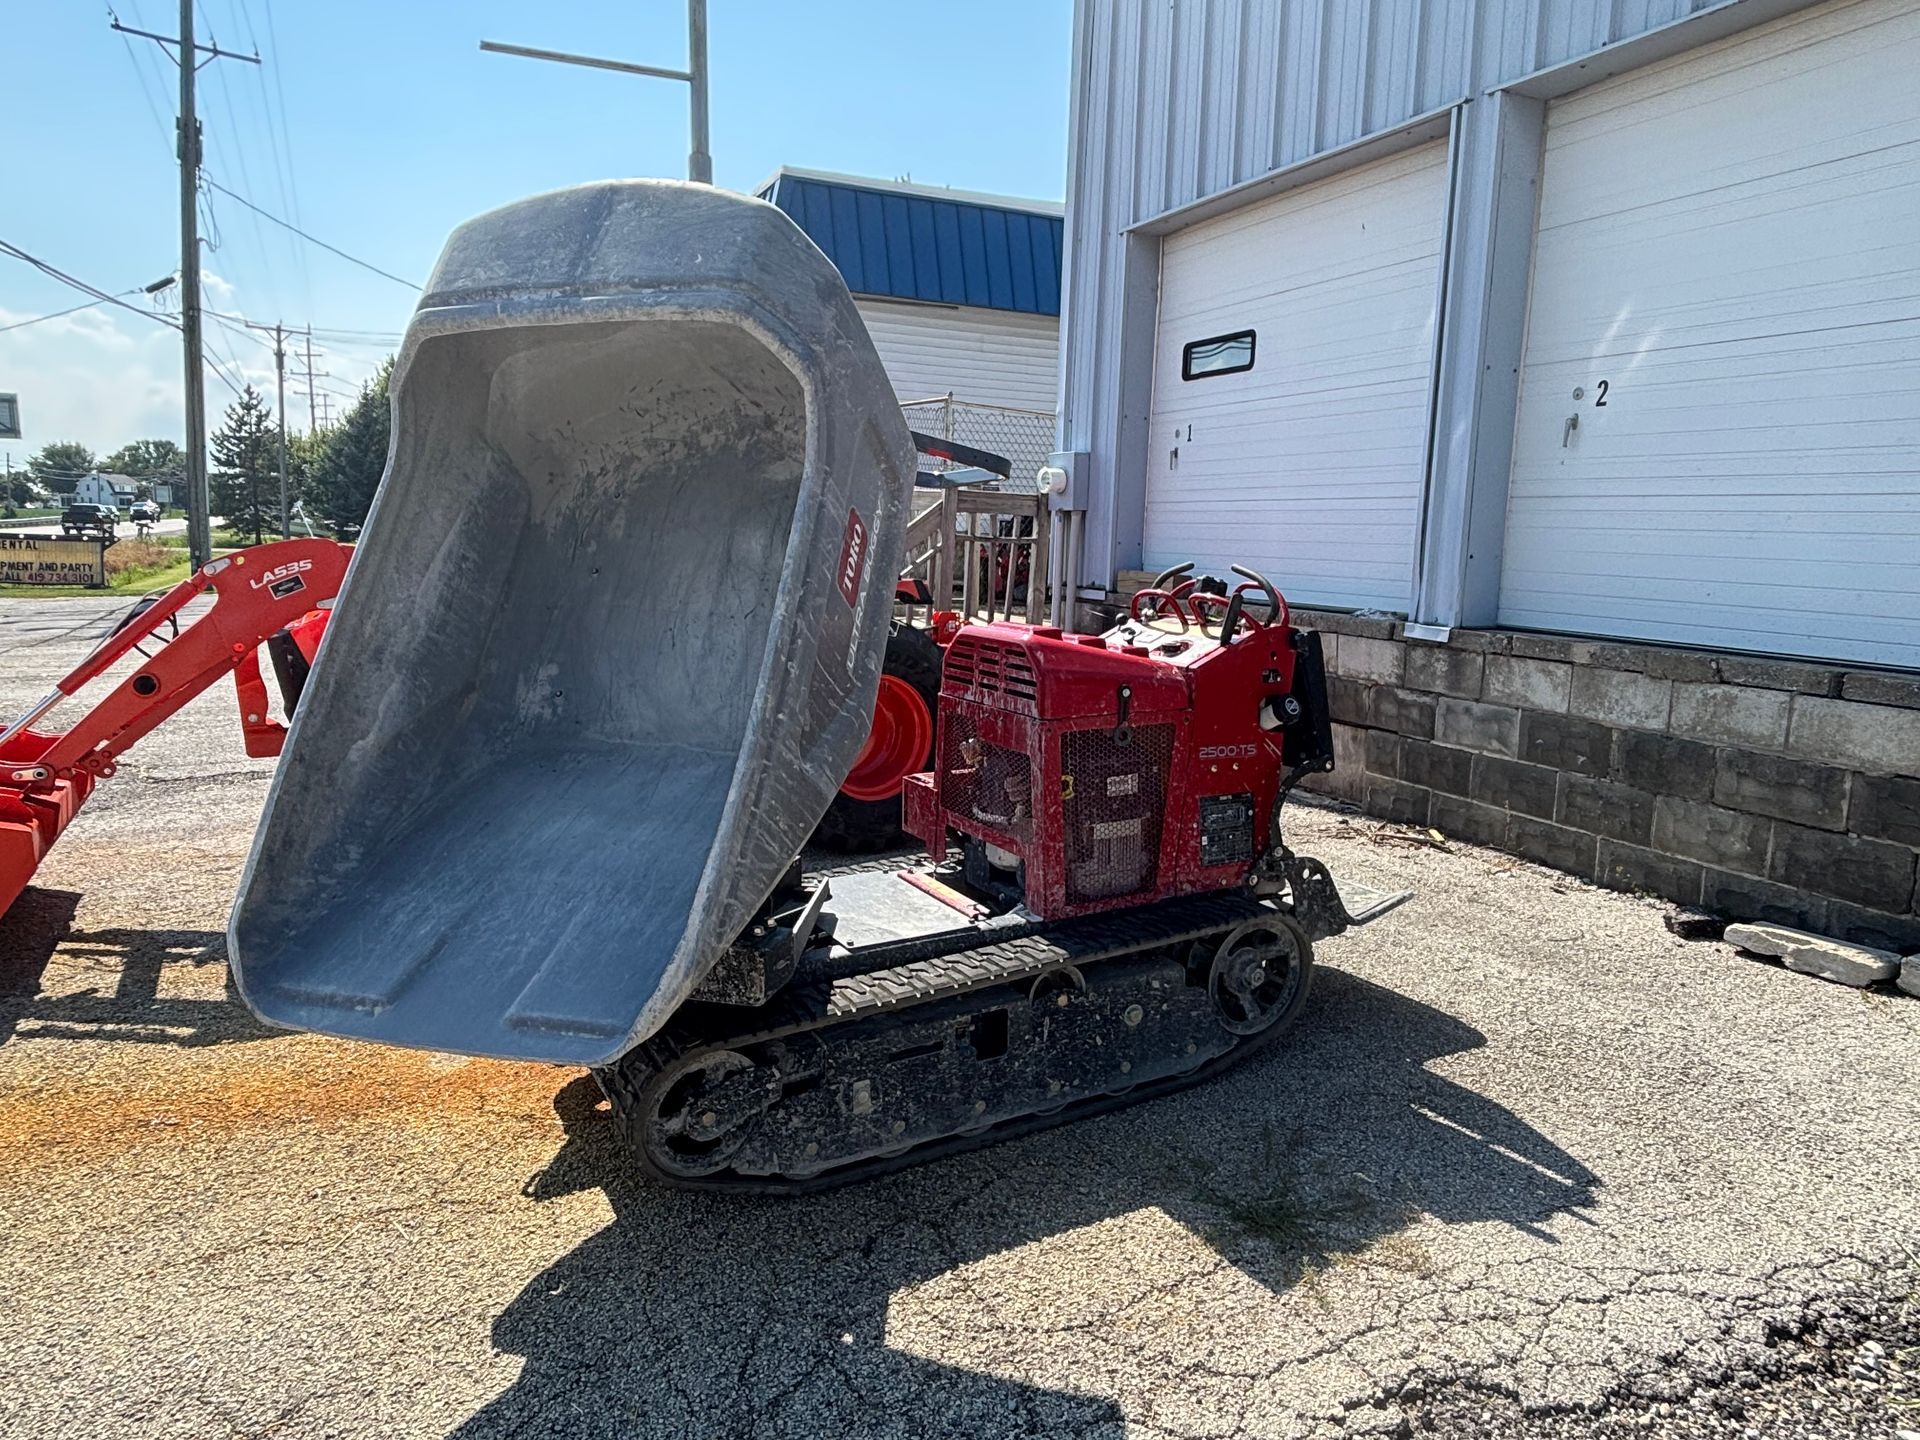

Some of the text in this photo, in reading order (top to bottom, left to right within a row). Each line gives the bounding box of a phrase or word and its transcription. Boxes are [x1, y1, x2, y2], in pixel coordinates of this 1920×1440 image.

[1595, 379, 1609, 407] 2
[1187, 423, 1192, 442] 1
[0, 540, 38, 550] ENTAL
[843, 523, 863, 593] TORO
[0, 561, 93, 572] PMENT AND PARTY
[249, 559, 313, 589] LA535
[846, 591, 867, 671] ULTRA
